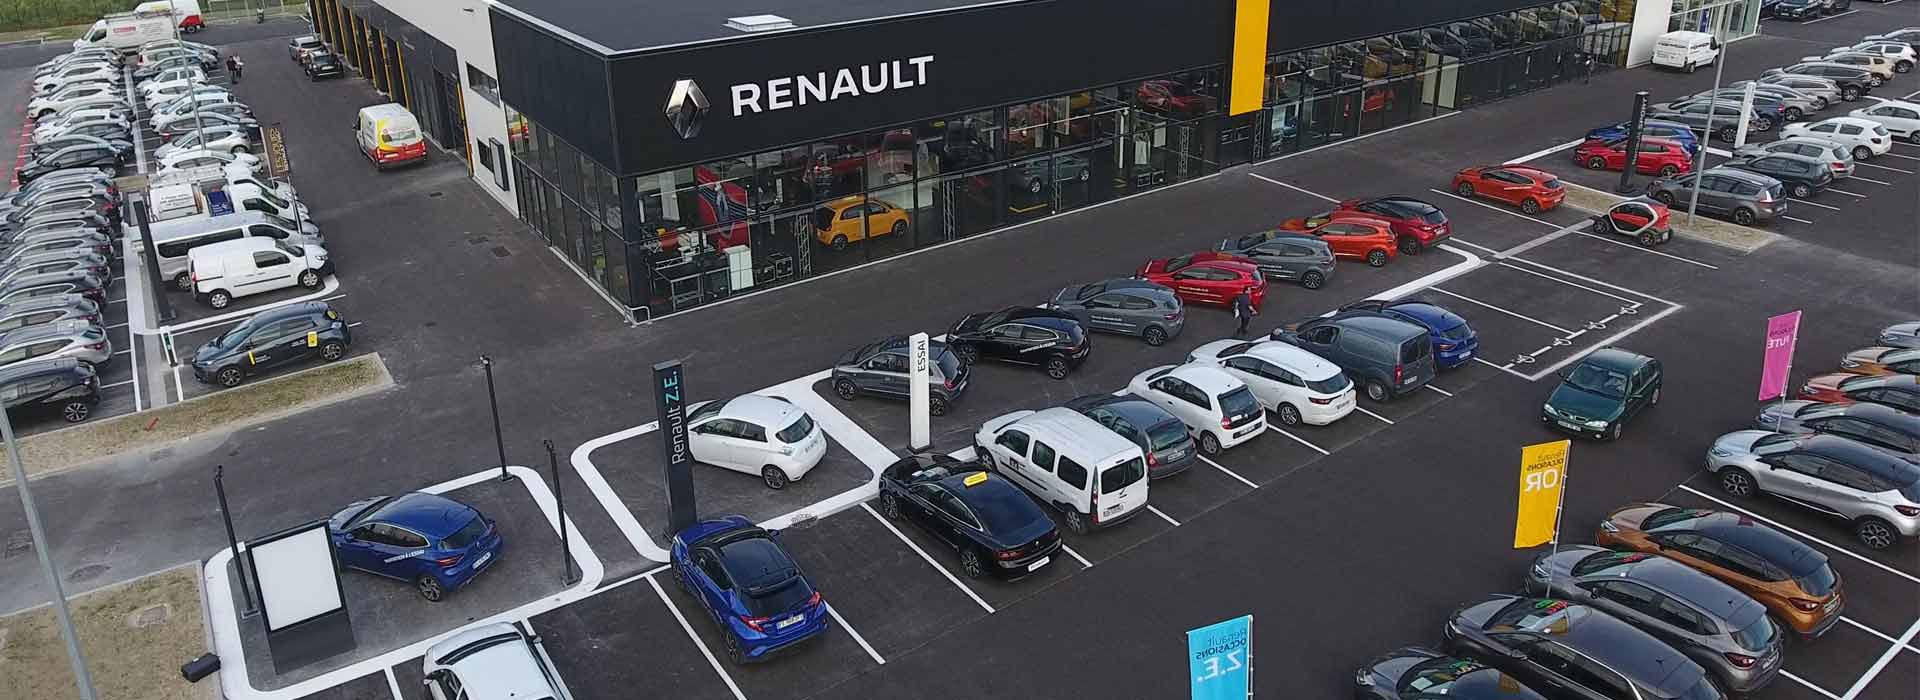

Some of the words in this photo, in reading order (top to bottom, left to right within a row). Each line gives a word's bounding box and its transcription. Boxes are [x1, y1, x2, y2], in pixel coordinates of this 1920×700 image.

[730, 55, 934, 117] RENAULT
[917, 340, 926, 373] ESSAI
[664, 371, 679, 404] Z.E.
[667, 405, 685, 464] Renault
